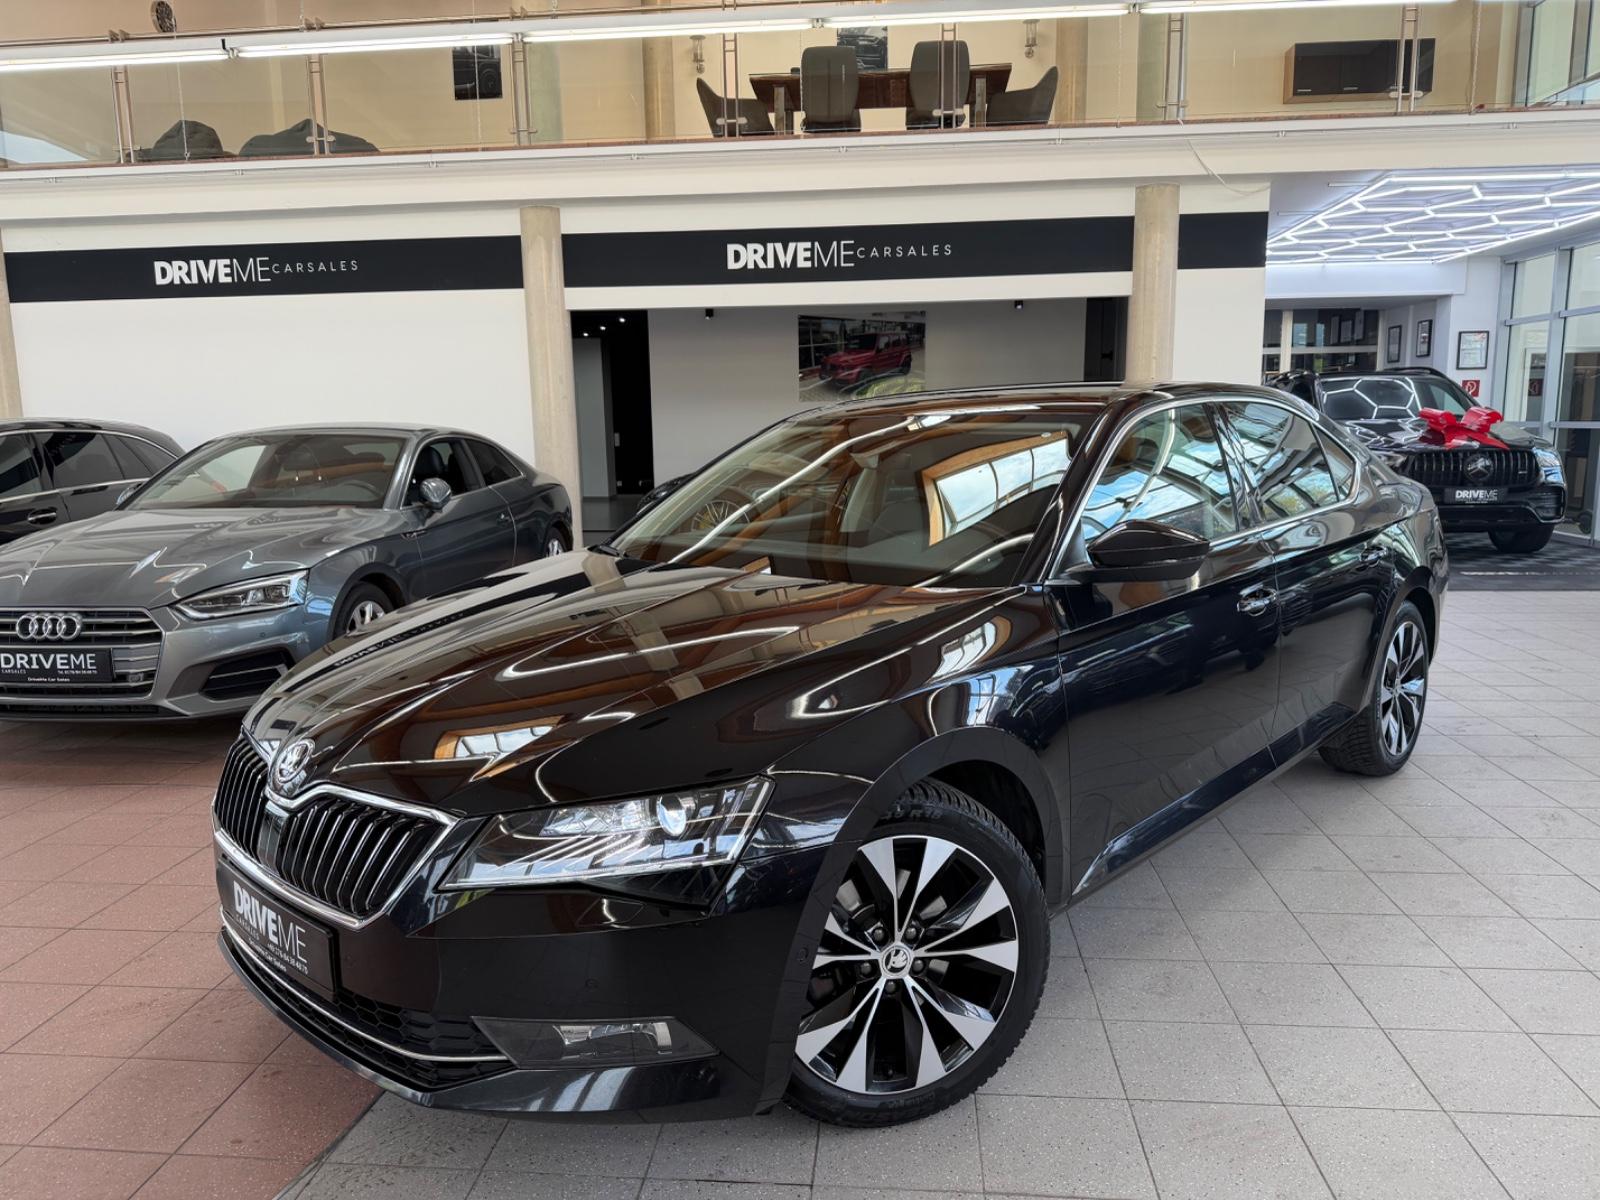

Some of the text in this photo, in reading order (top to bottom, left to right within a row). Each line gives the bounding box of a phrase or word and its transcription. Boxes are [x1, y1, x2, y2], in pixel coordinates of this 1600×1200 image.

[726, 240, 953, 270] DRIVEME CARSALES
[153, 257, 360, 286] DRIVEME CARSALES
[0, 653, 97, 669] DRIVEME
[233, 880, 307, 964] DRIVEME
